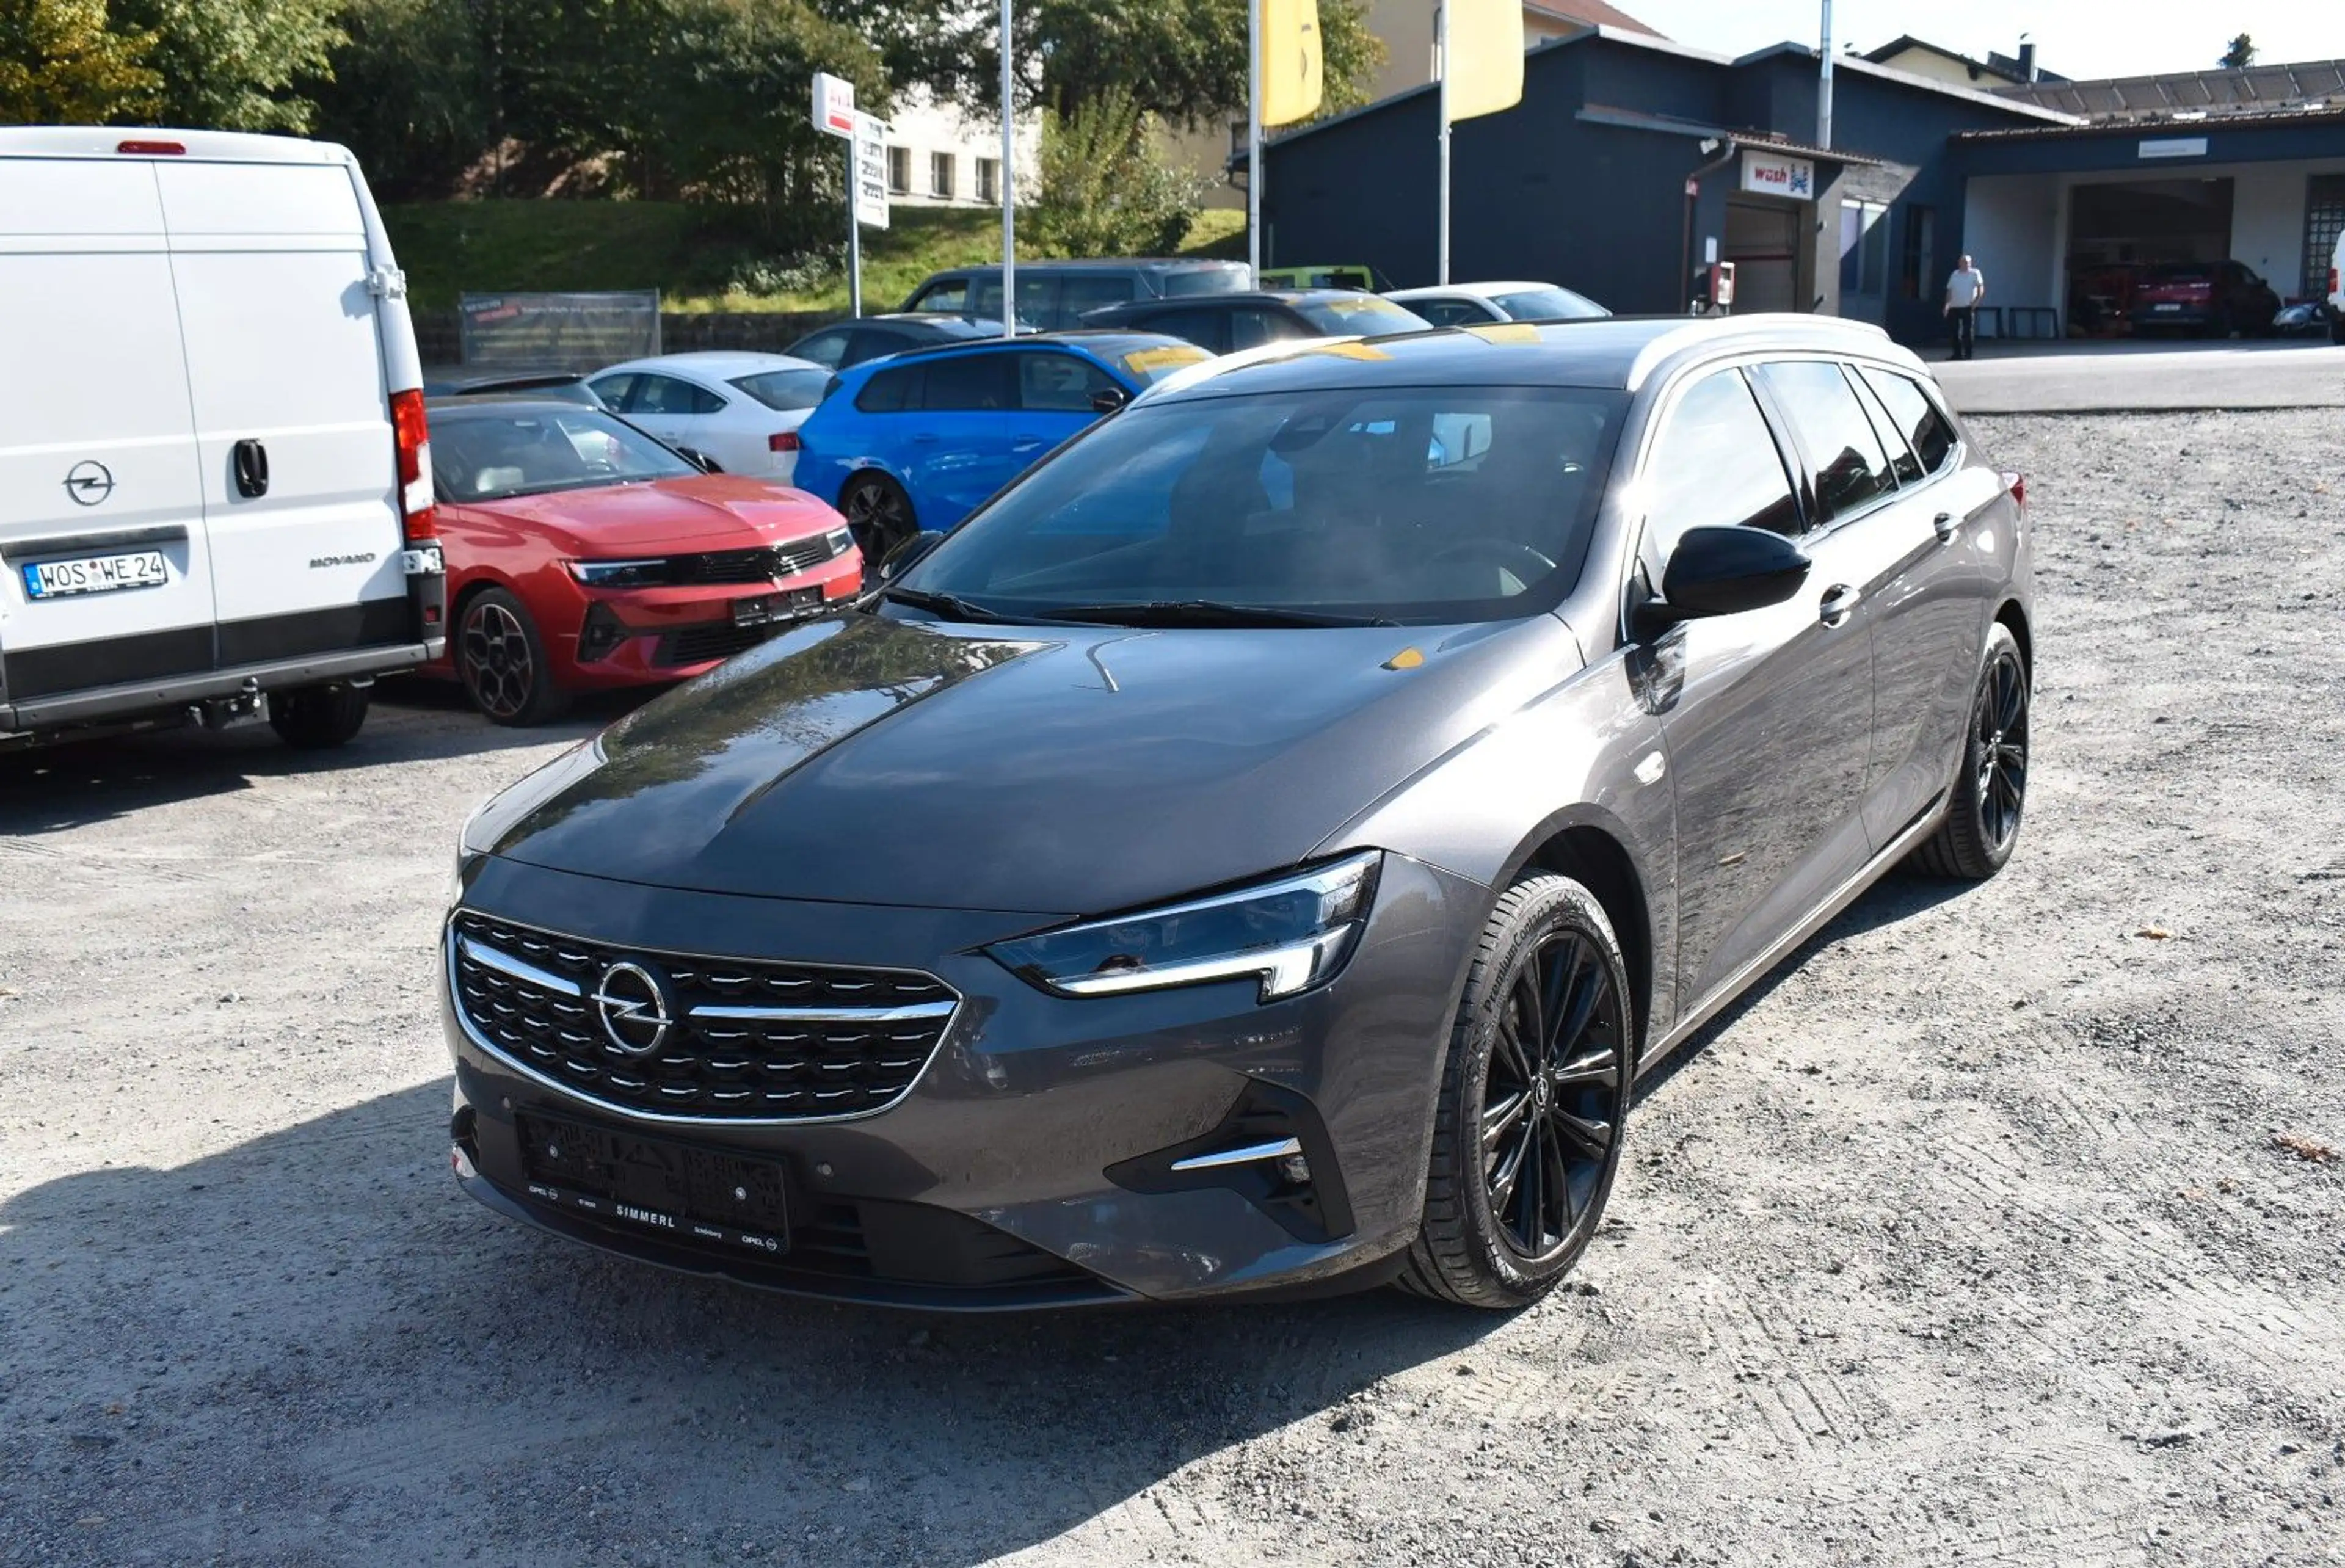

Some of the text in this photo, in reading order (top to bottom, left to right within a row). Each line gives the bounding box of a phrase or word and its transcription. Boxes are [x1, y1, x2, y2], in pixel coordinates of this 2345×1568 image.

[1754, 166, 1787, 183] wash
[40, 555, 161, 588] WOS WE 24
[310, 553, 376, 568] MOVANO
[616, 1204, 675, 1228] SIMMERL
[741, 1235, 765, 1247] OPEL
